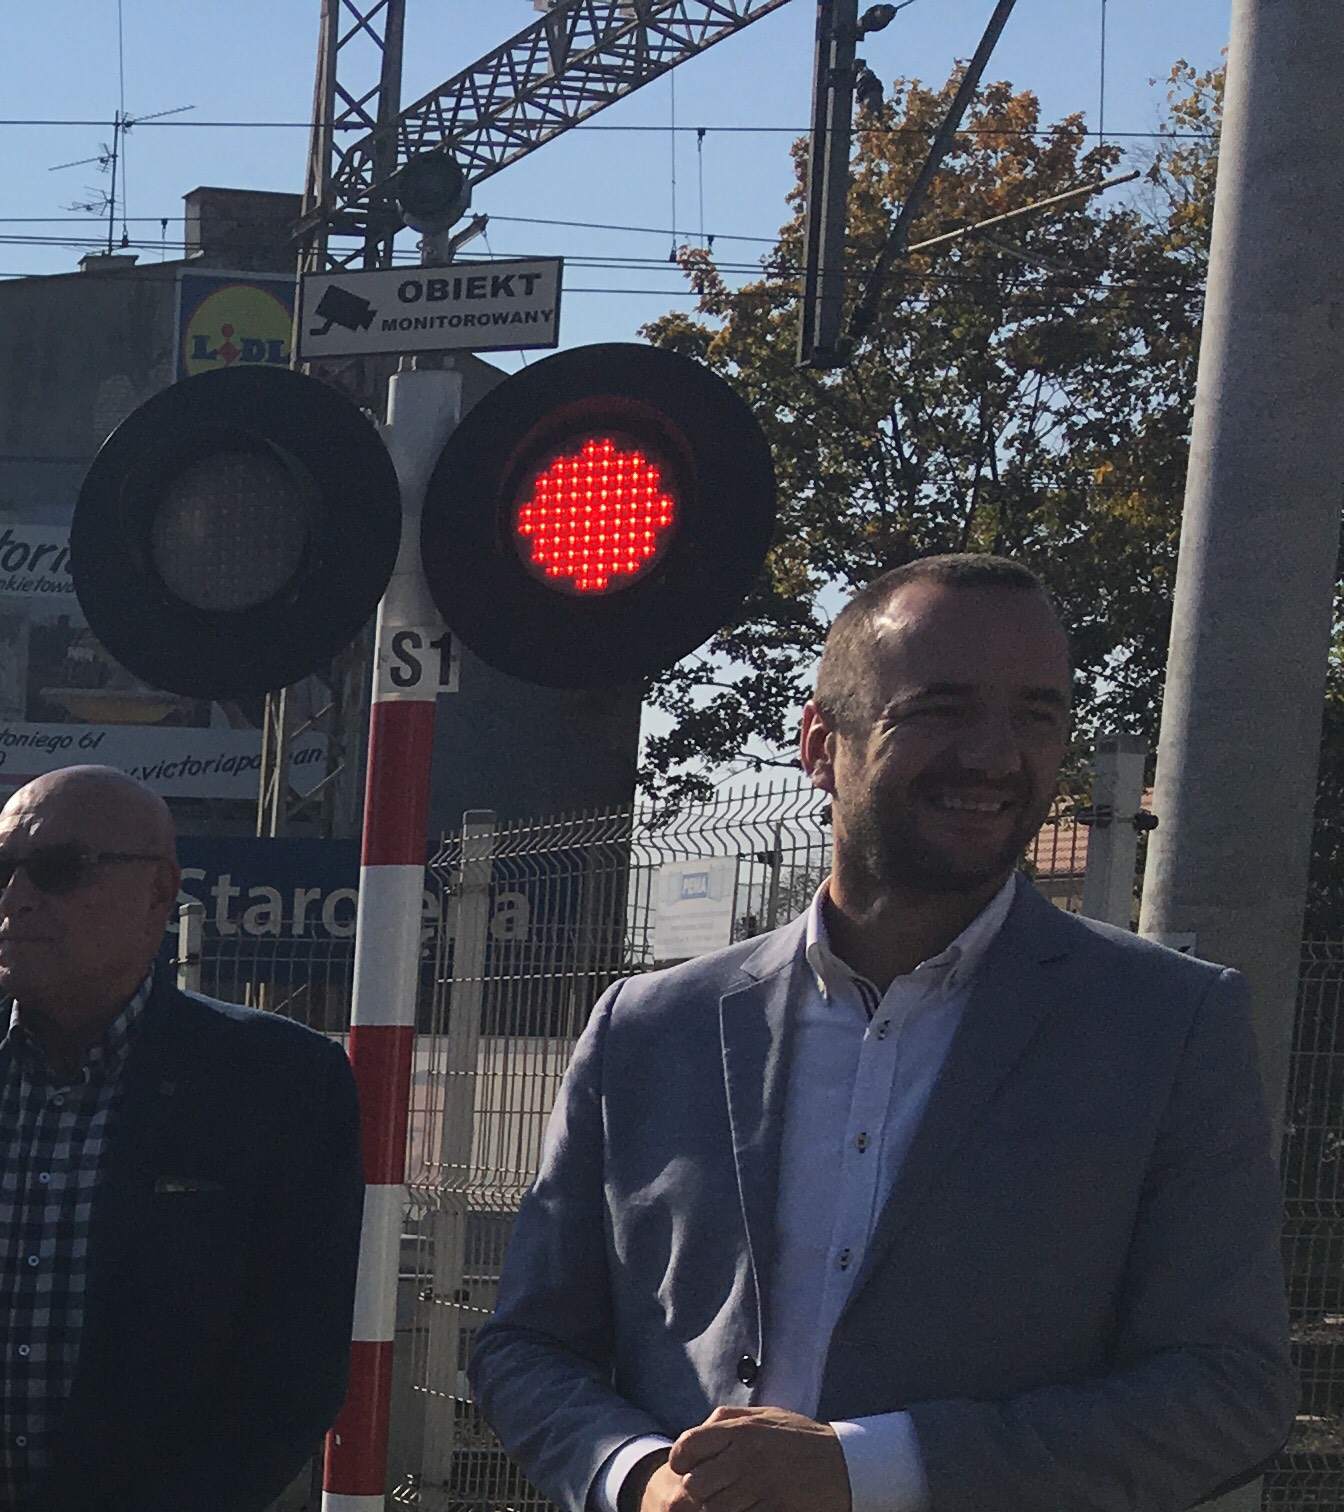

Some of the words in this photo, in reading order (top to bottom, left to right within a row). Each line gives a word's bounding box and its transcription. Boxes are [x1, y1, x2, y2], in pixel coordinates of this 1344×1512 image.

[397, 271, 542, 304] OBIEKT
[381, 309, 555, 332] MONITOROWANY
[390, 630, 452, 688] S1
